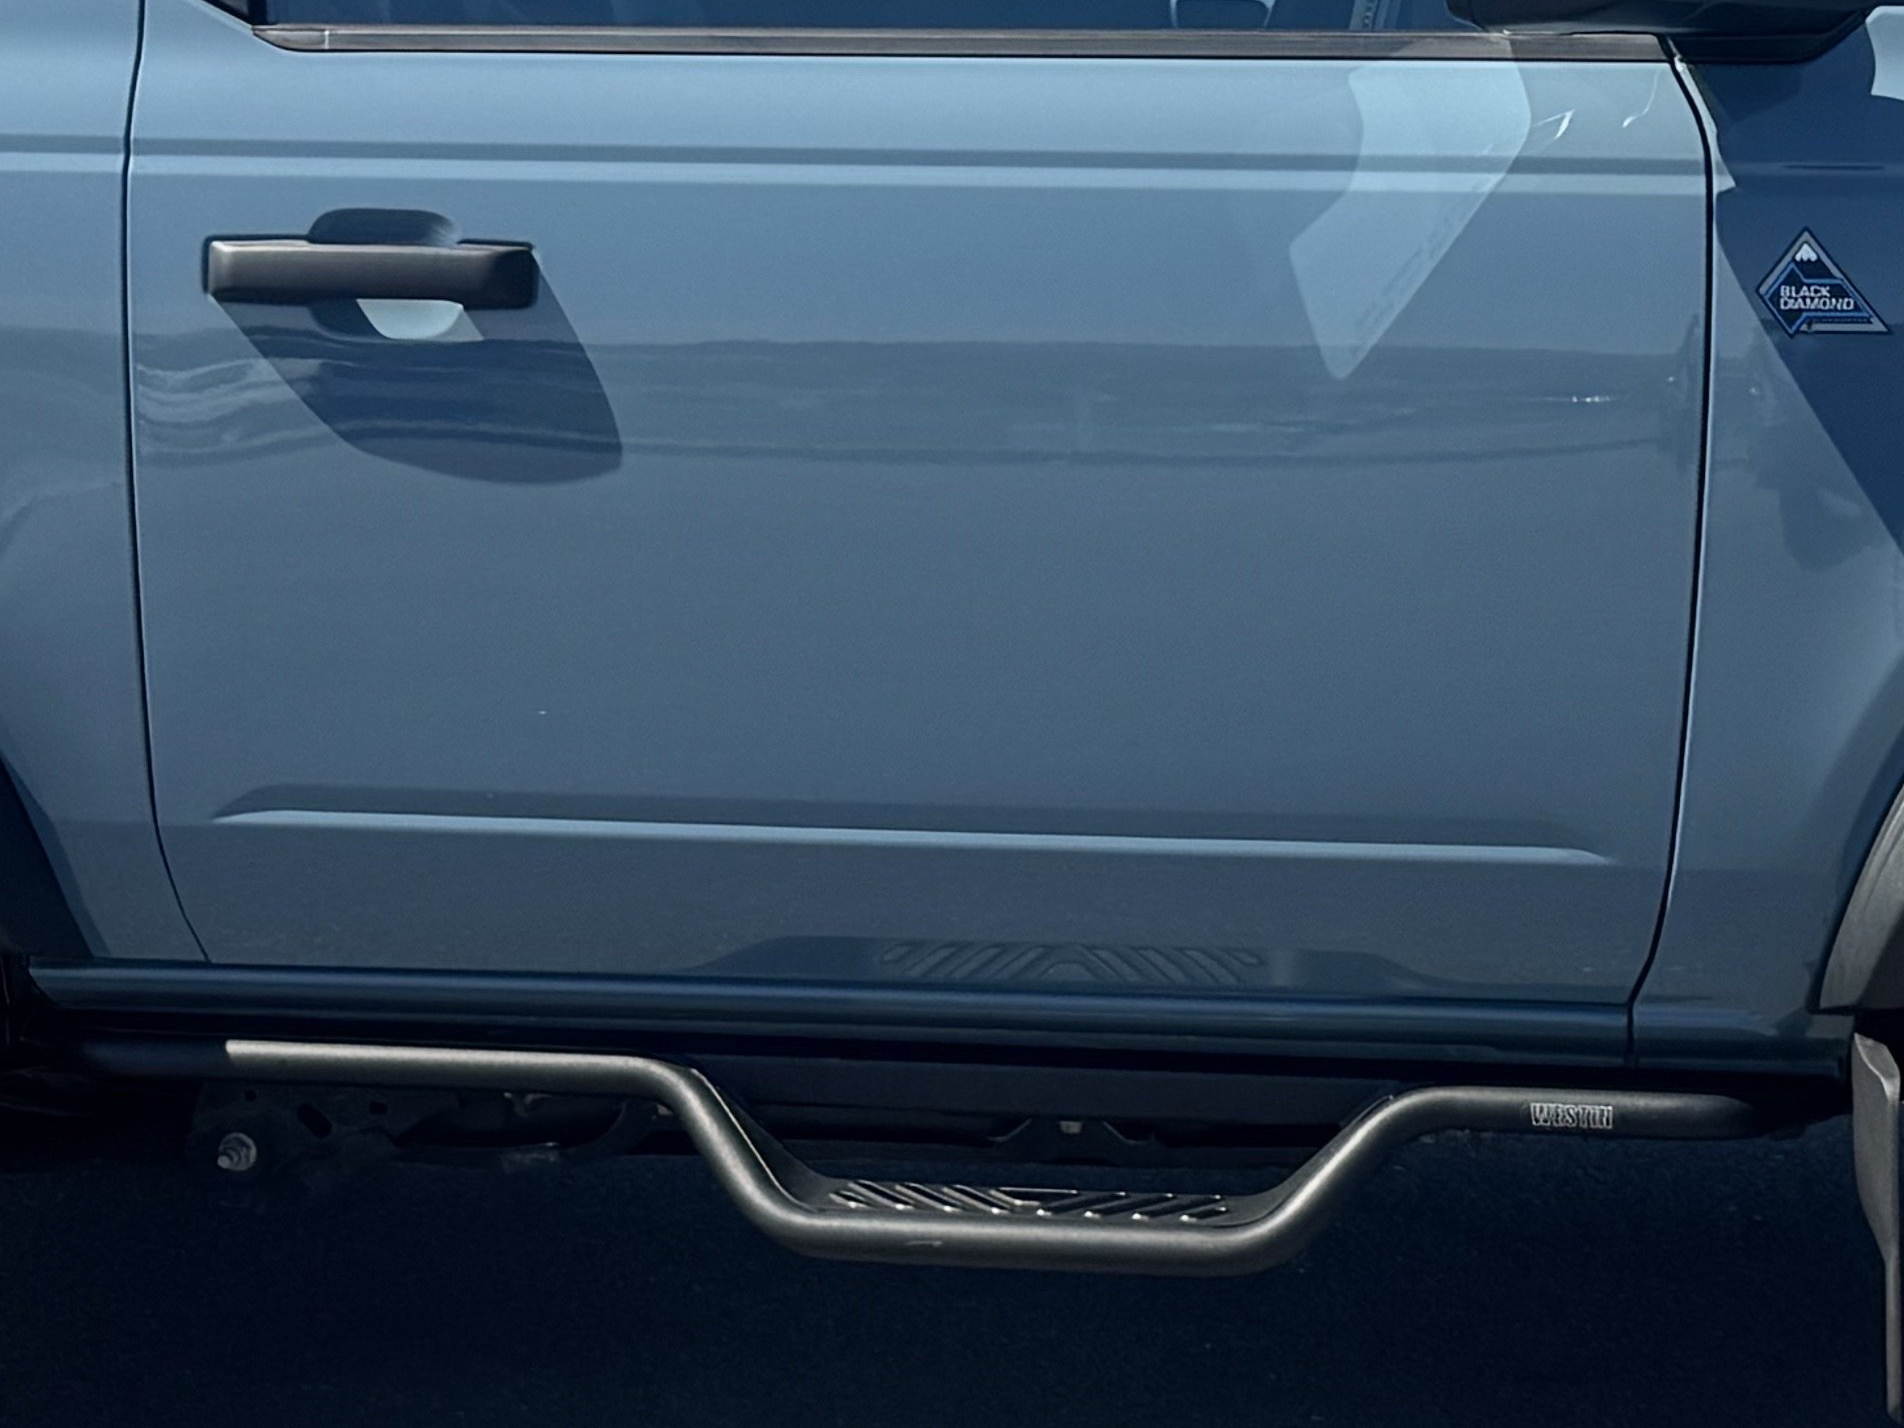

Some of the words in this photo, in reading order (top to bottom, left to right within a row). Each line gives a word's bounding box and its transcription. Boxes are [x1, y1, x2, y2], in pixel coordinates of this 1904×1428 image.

[1779, 285, 1831, 298] BLACK
[1779, 297, 1855, 311] DIAMOND
[1531, 1103, 1613, 1129] WESTIN
